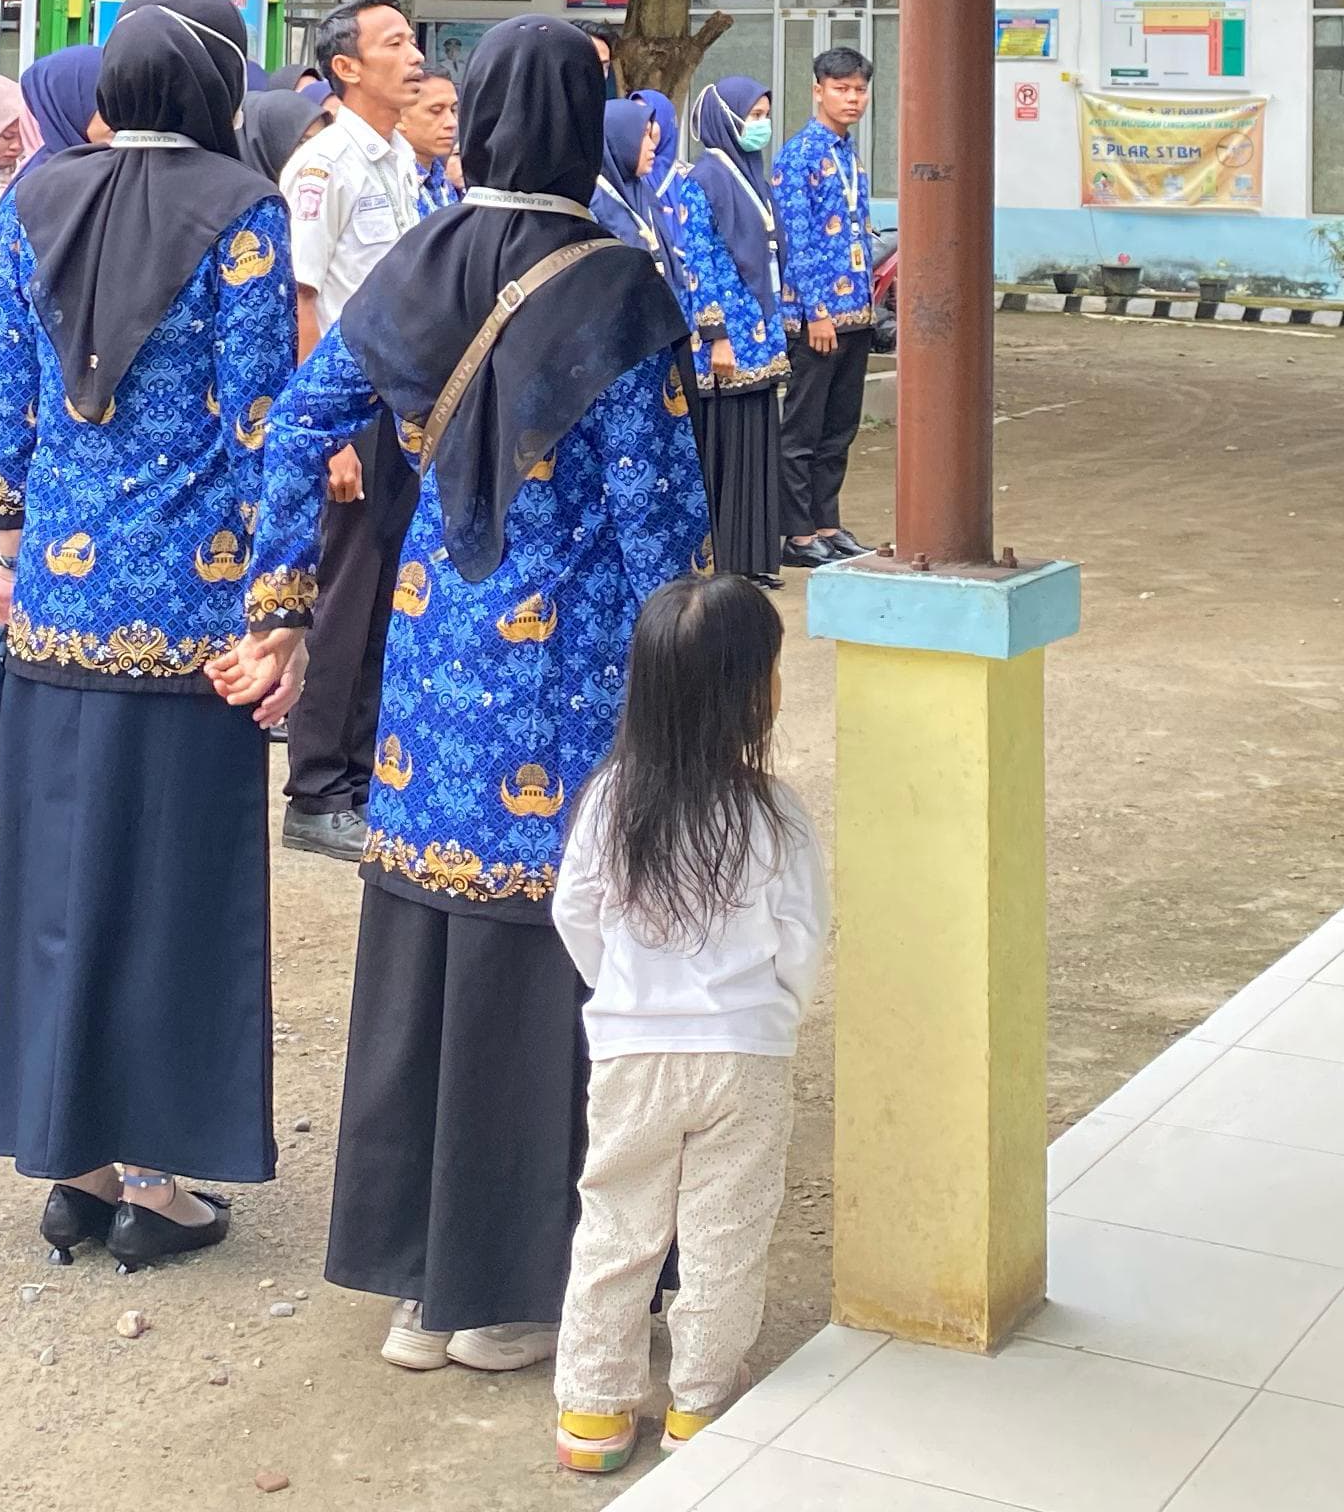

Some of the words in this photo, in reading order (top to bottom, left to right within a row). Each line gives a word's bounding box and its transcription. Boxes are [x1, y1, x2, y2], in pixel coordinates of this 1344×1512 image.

[1092, 144, 1099, 156] 5
[1106, 144, 1149, 159] PILAR
[1156, 146, 1202, 159] STBM
